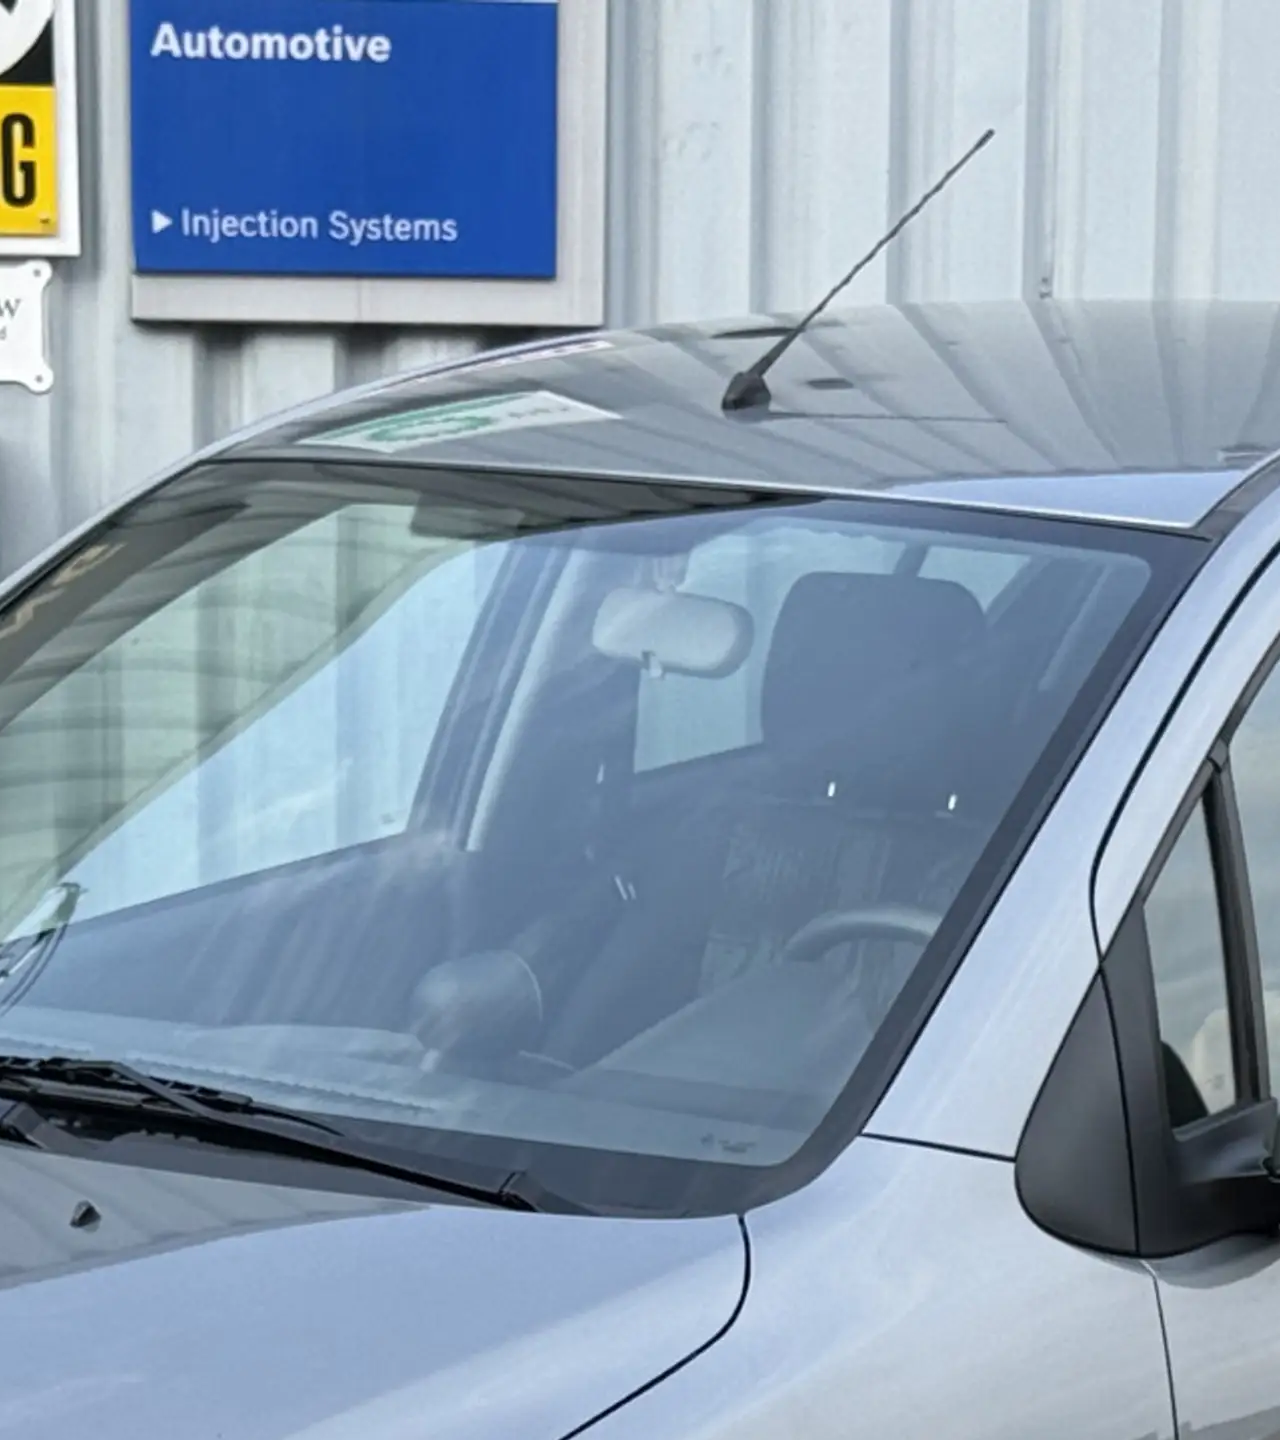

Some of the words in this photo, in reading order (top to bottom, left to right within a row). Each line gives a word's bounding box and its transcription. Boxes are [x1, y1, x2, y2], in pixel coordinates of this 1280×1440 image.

[150, 21, 393, 63] Automotive
[181, 207, 319, 244] Injection
[328, 209, 459, 247] Systems
